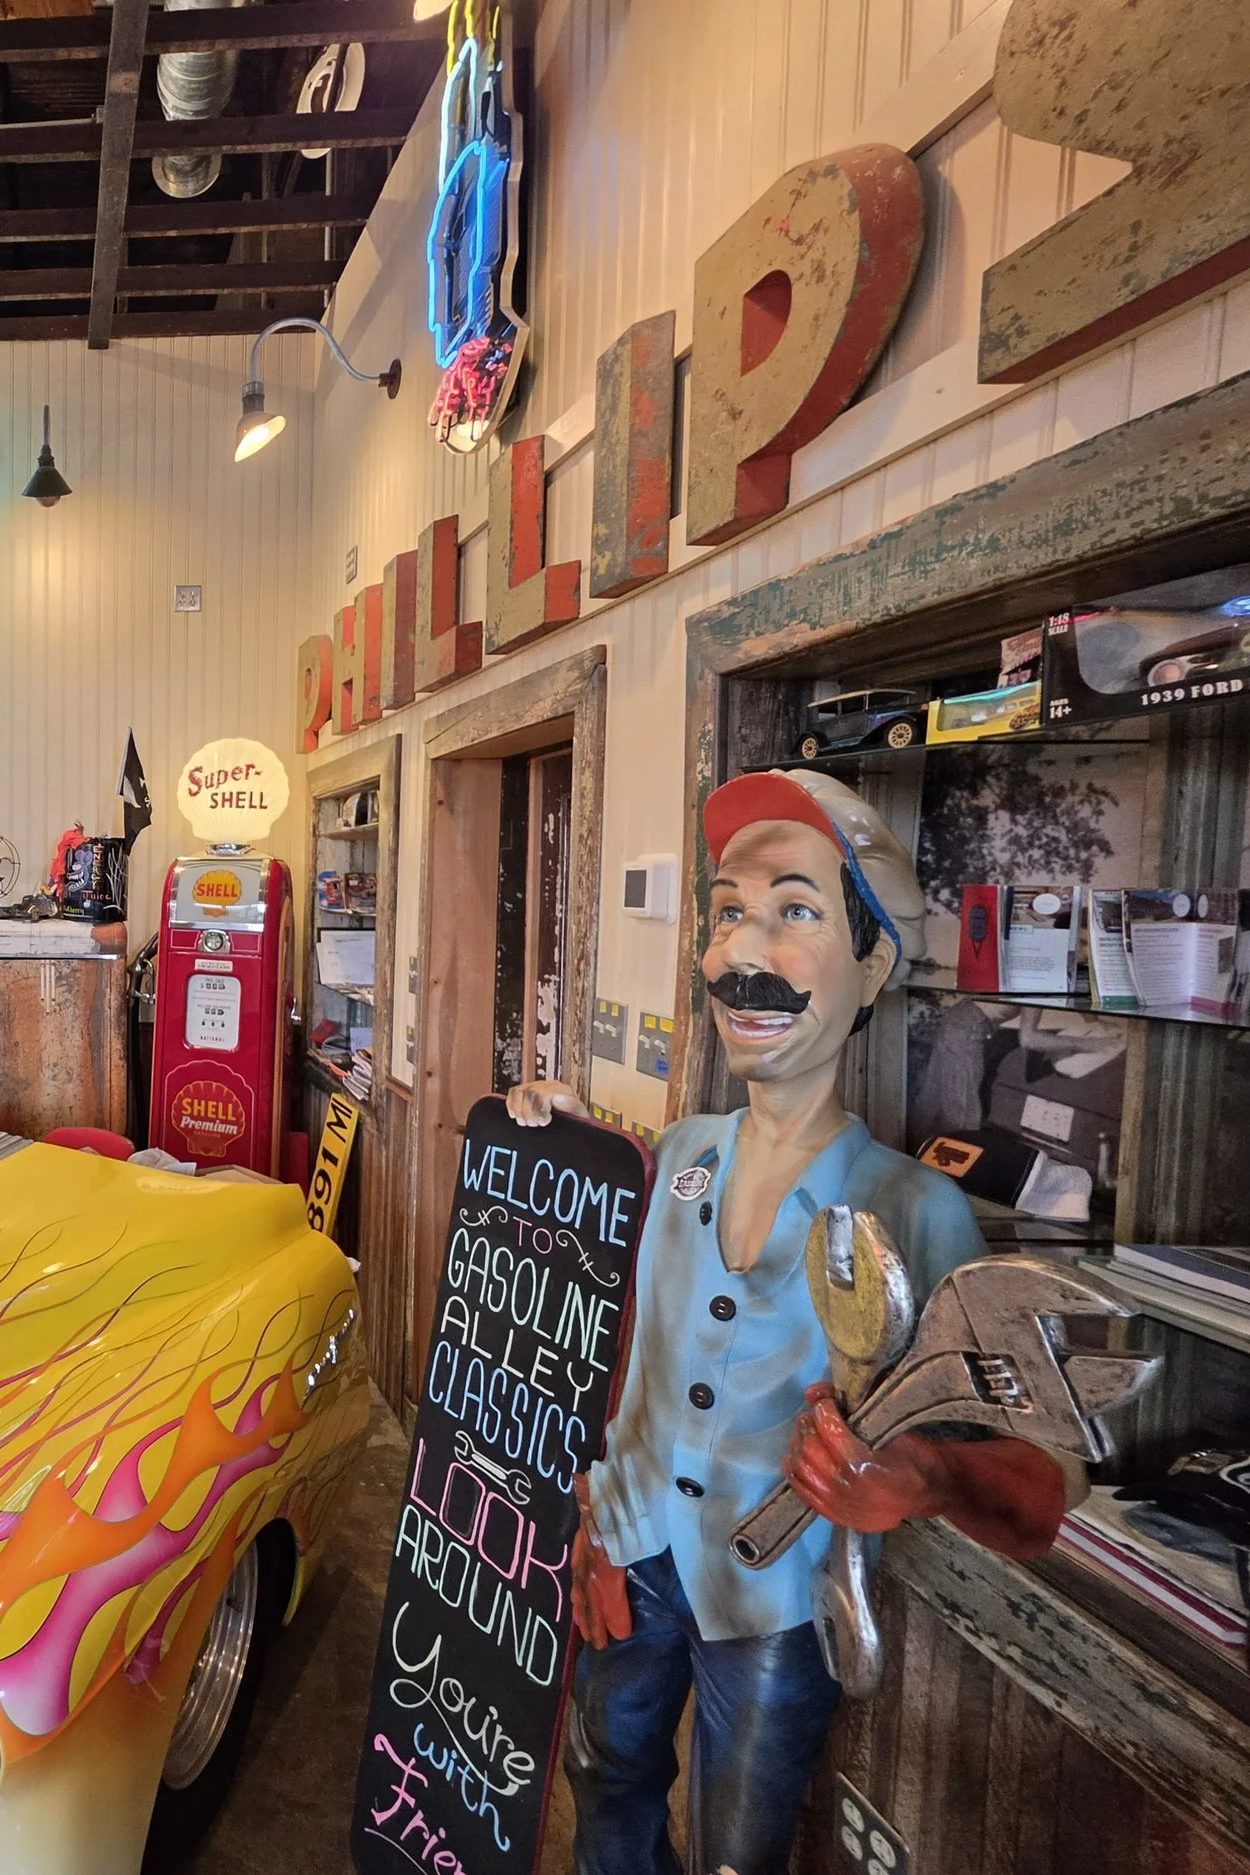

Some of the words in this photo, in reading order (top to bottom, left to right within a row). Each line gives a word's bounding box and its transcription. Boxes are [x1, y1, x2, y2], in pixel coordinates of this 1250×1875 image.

[1048, 612, 1070, 627] 1:18
[1140, 688, 1185, 706] 1939
[1190, 679, 1244, 698] FORD
[1050, 705, 1072, 719] 14+
[188, 762, 263, 797] Super-
[210, 791, 268, 810] SHELL
[196, 883, 238, 898] SHELL
[179, 1115, 238, 1135] Premium
[181, 1097, 236, 1121] SHELL
[463, 1138, 636, 1247] WELCOME
[512, 1216, 553, 1254] TO
[447, 1227, 619, 1372] GASOLINE
[440, 1295, 594, 1412] ALLEY
[428, 1340, 586, 1494] CLASSICS
[410, 1438, 568, 1623] LOOK
[396, 1504, 558, 1687] AROUND
[370, 1733, 469, 1875] Frie
[413, 1722, 511, 1852] with
